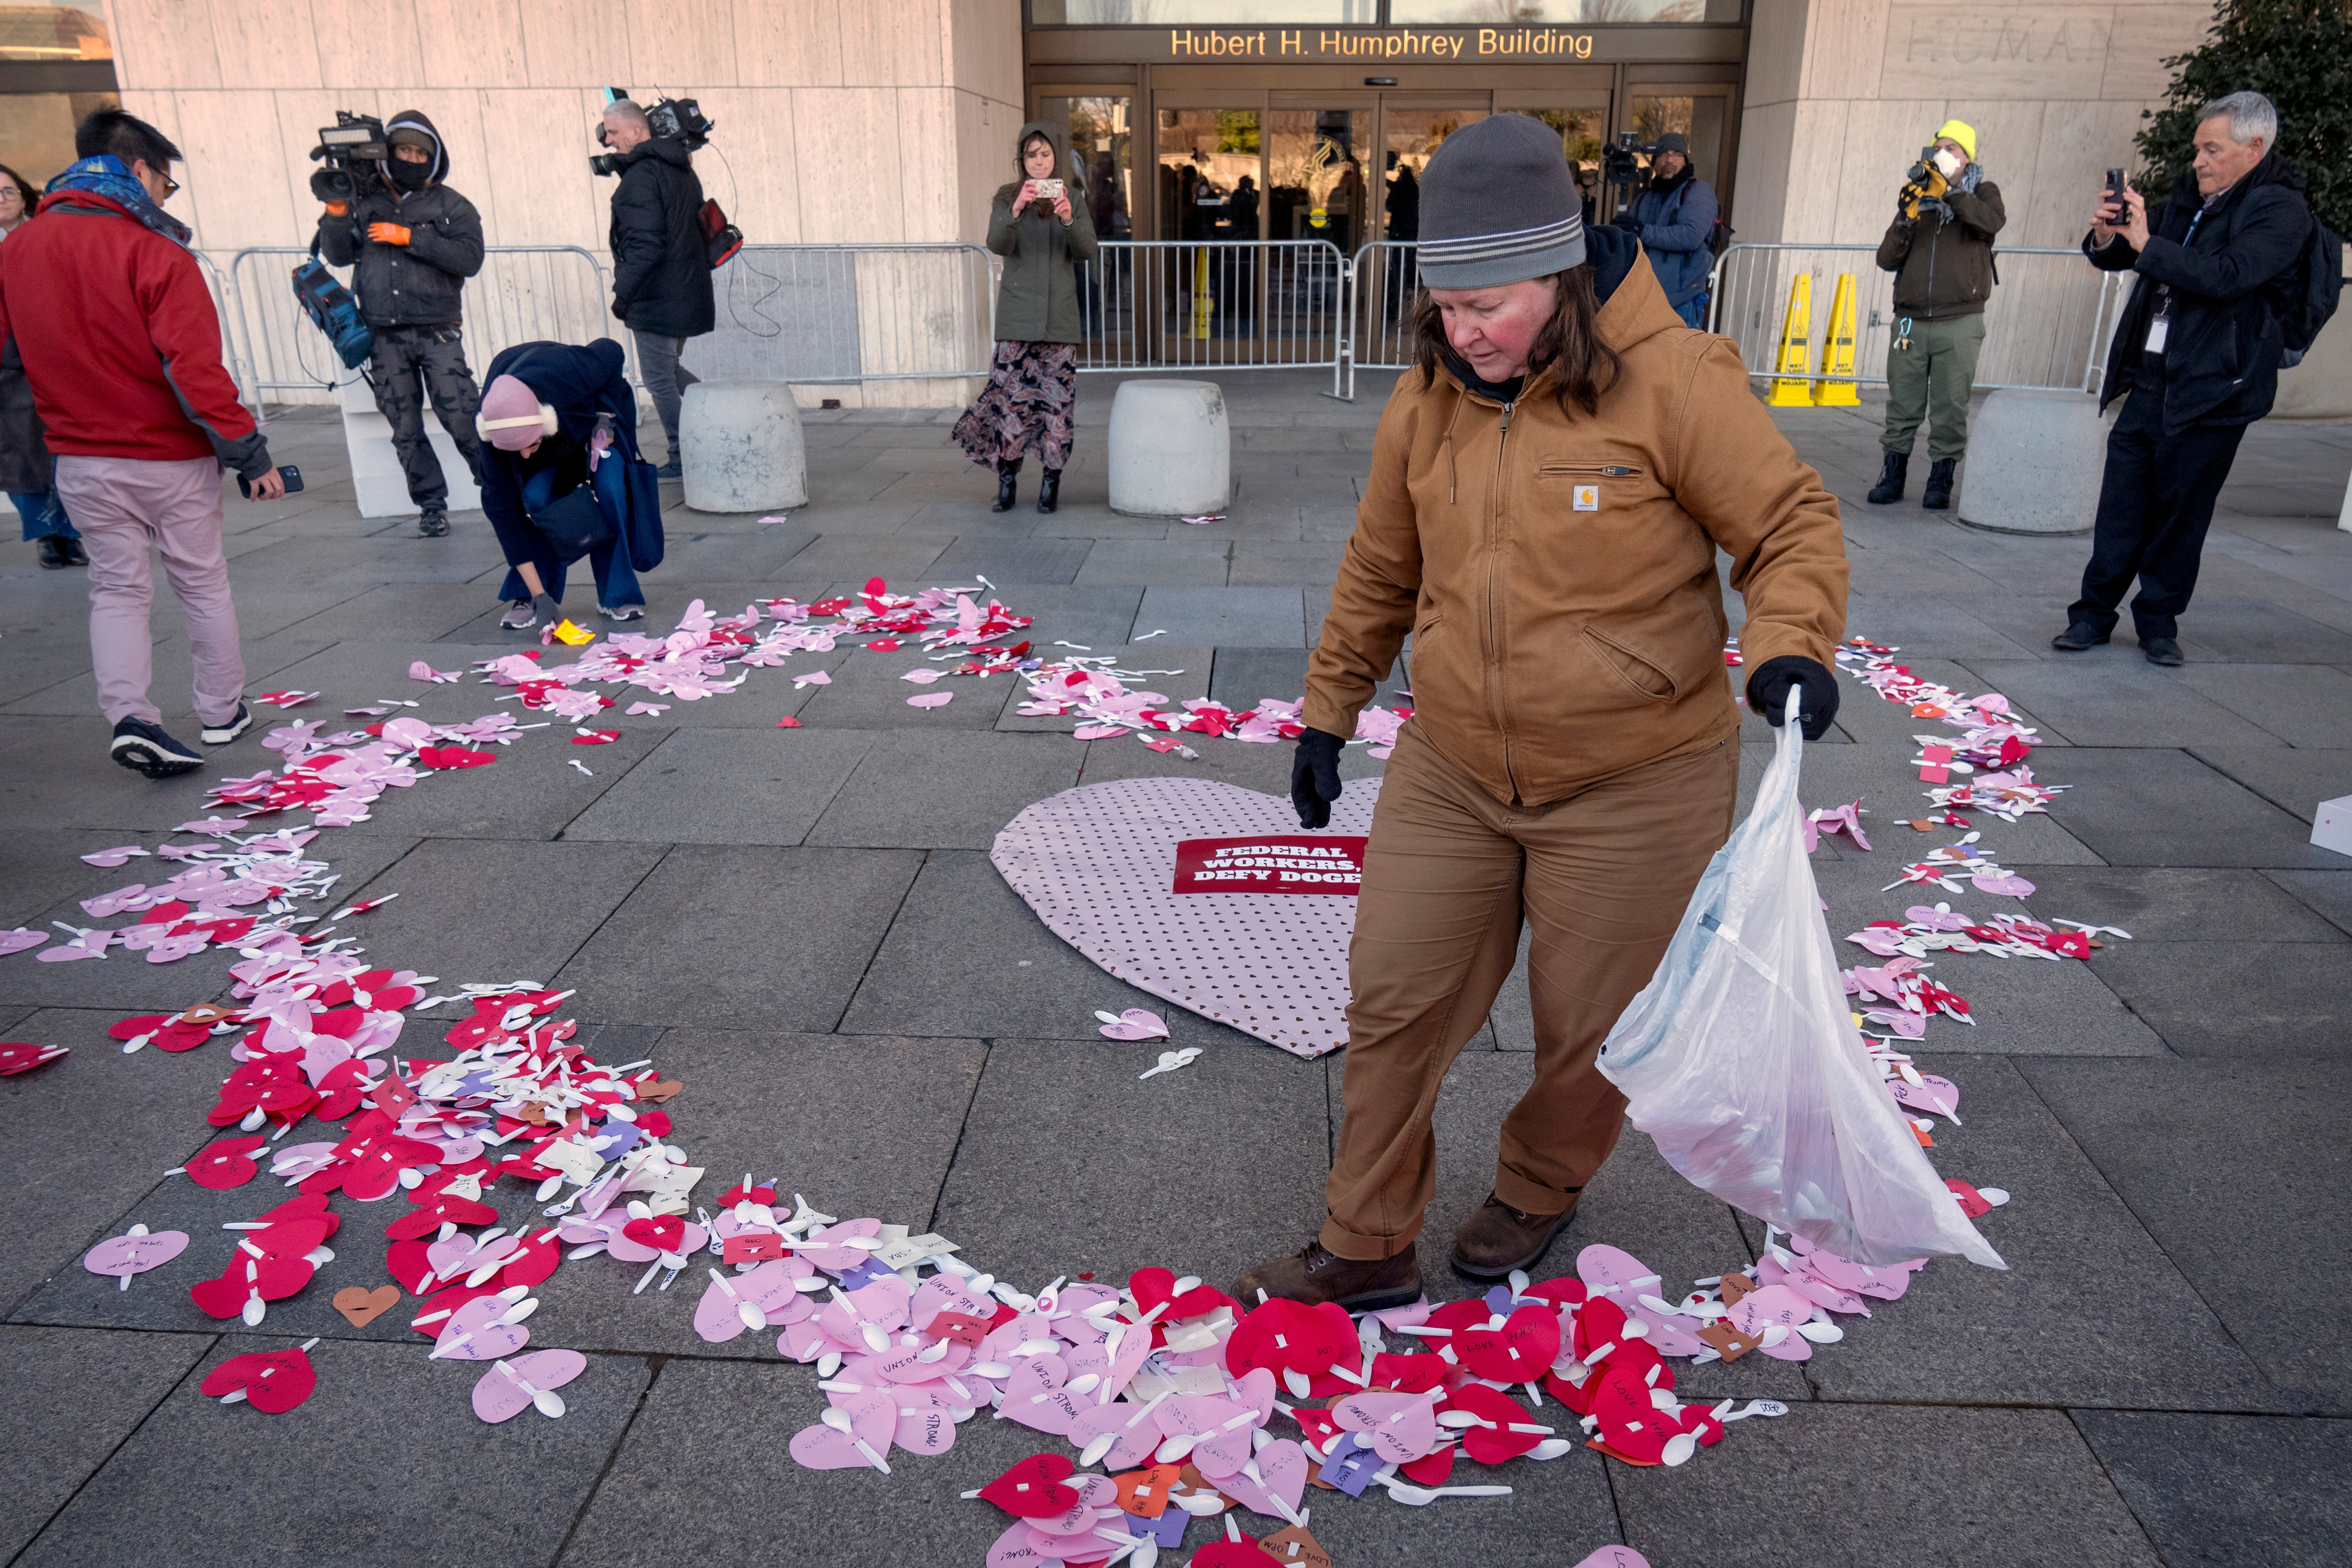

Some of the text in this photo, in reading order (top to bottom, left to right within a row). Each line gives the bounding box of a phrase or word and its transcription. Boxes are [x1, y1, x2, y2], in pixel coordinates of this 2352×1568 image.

[1172, 29, 1593, 59] Hubert H. Humphrey Building
[1905, 18, 2125, 64] HUMAN
[1216, 845, 1347, 857] FEDERAL
[1203, 857, 1361, 872] WORKERS,
[1194, 870, 1362, 883] DEFY DOGE
[924, 1239, 948, 1249] LOVE
[888, 1251, 907, 1261] SBA
[929, 1278, 991, 1317] UNION STRNG!
[483, 1300, 497, 1313] We
[1316, 1345, 1333, 1356] LOVE
[1466, 1340, 1495, 1353] LOVE
[883, 1351, 918, 1373] UNION
[1031, 1360, 1080, 1420] UNION STRON
[1613, 1379, 1639, 1408] LOVE
[1346, 1404, 1382, 1427] STRONG!
[926, 1413, 941, 1447] STRONG!
[1379, 1431, 1415, 1459] UNION
[1147, 1469, 1160, 1485] LOVE
[1335, 1470, 1351, 1487] LOVE
[1062, 1505, 1084, 1531] STRONG!
[1264, 1540, 1284, 1553] OPM
[1306, 1552, 1329, 1567] LOVE
